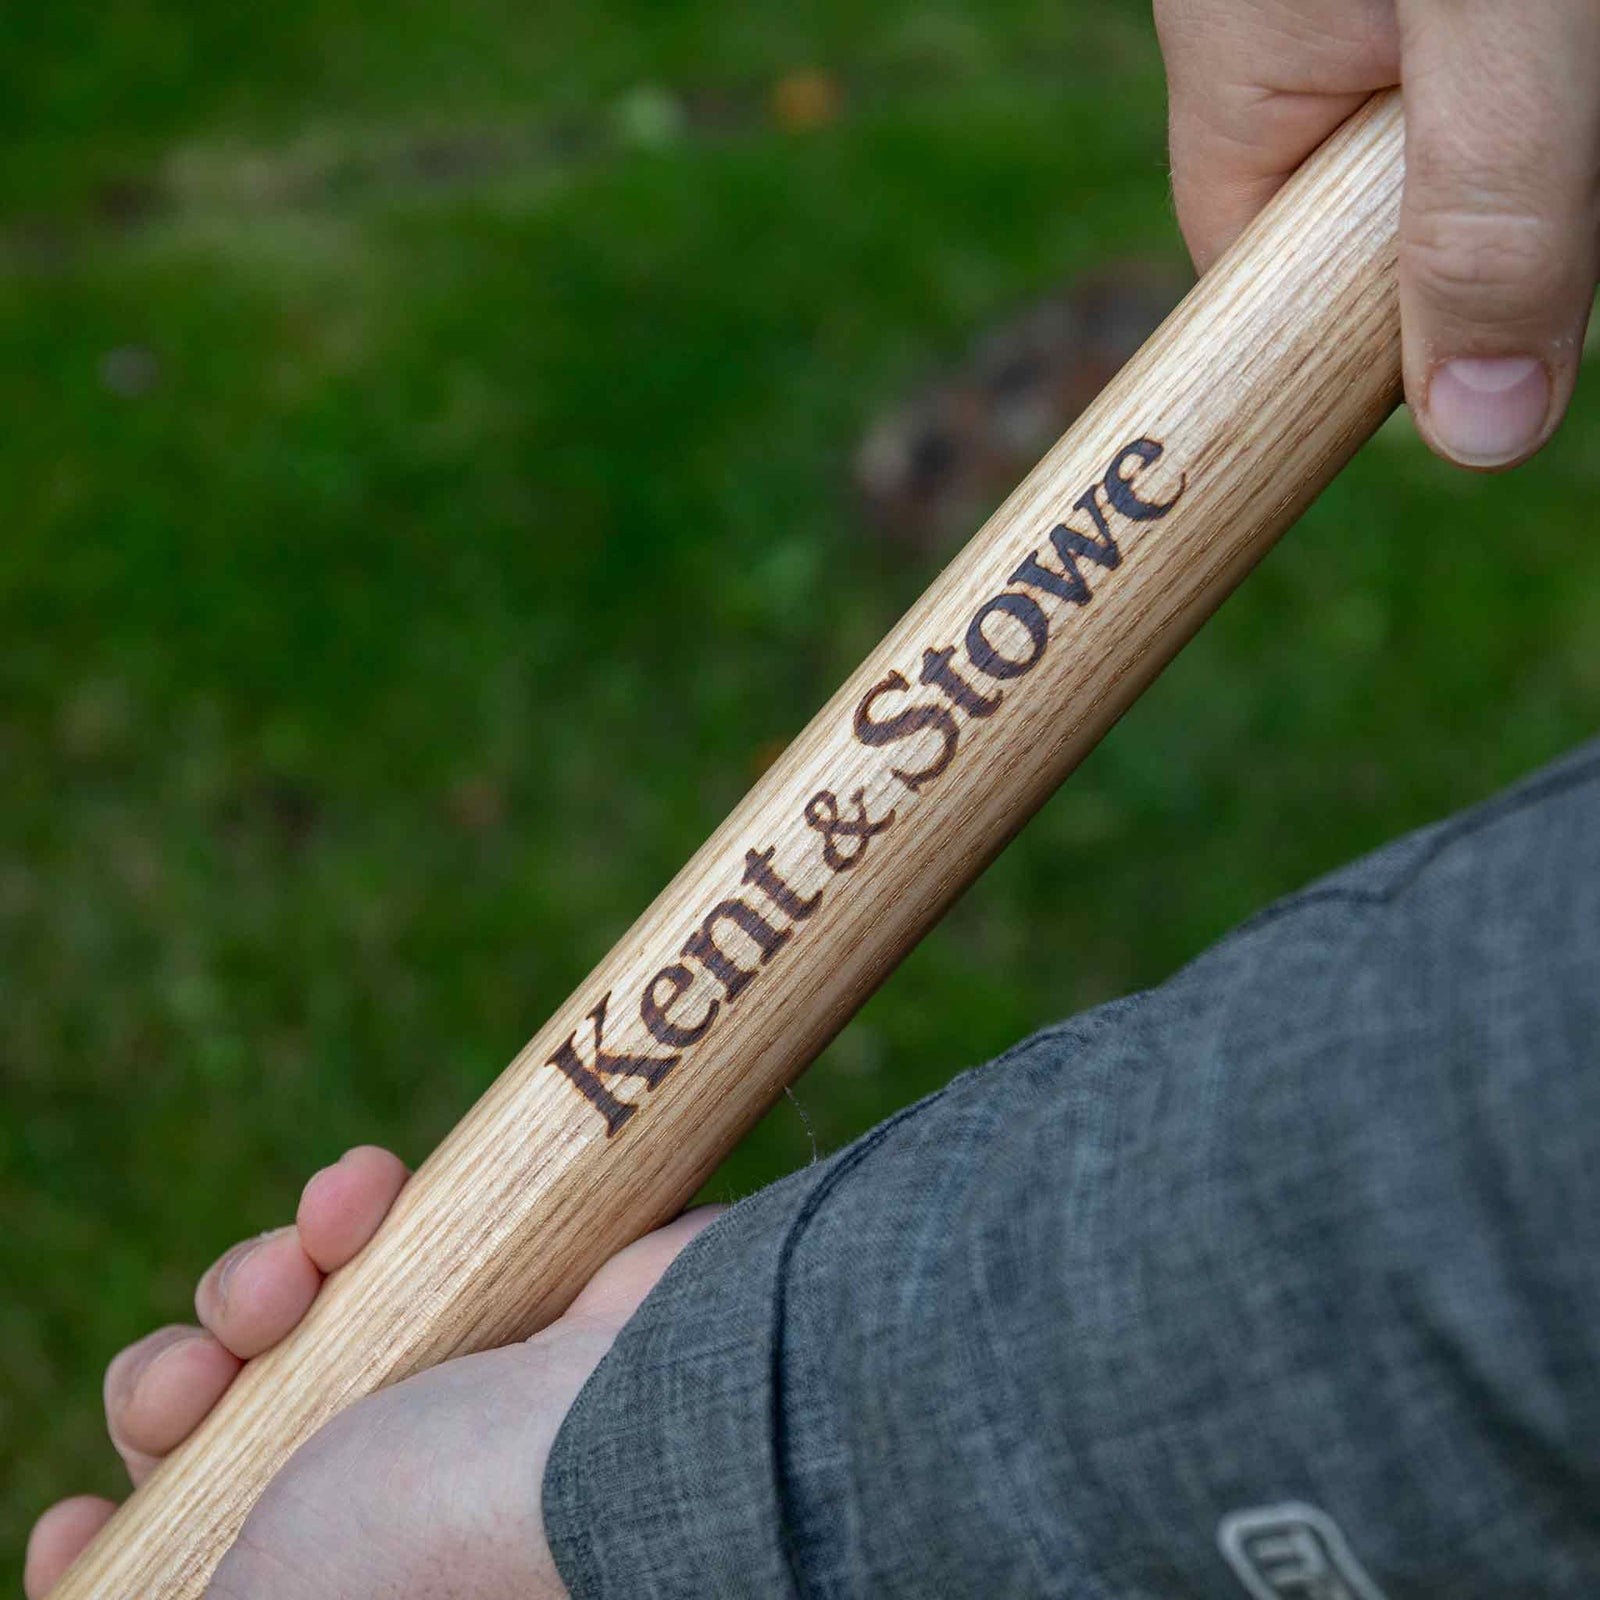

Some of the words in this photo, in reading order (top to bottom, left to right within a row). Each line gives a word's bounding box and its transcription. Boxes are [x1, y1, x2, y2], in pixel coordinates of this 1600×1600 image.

[545, 845, 823, 1138] Kent
[804, 786, 896, 873] &
[852, 434, 1187, 791] Stowe
